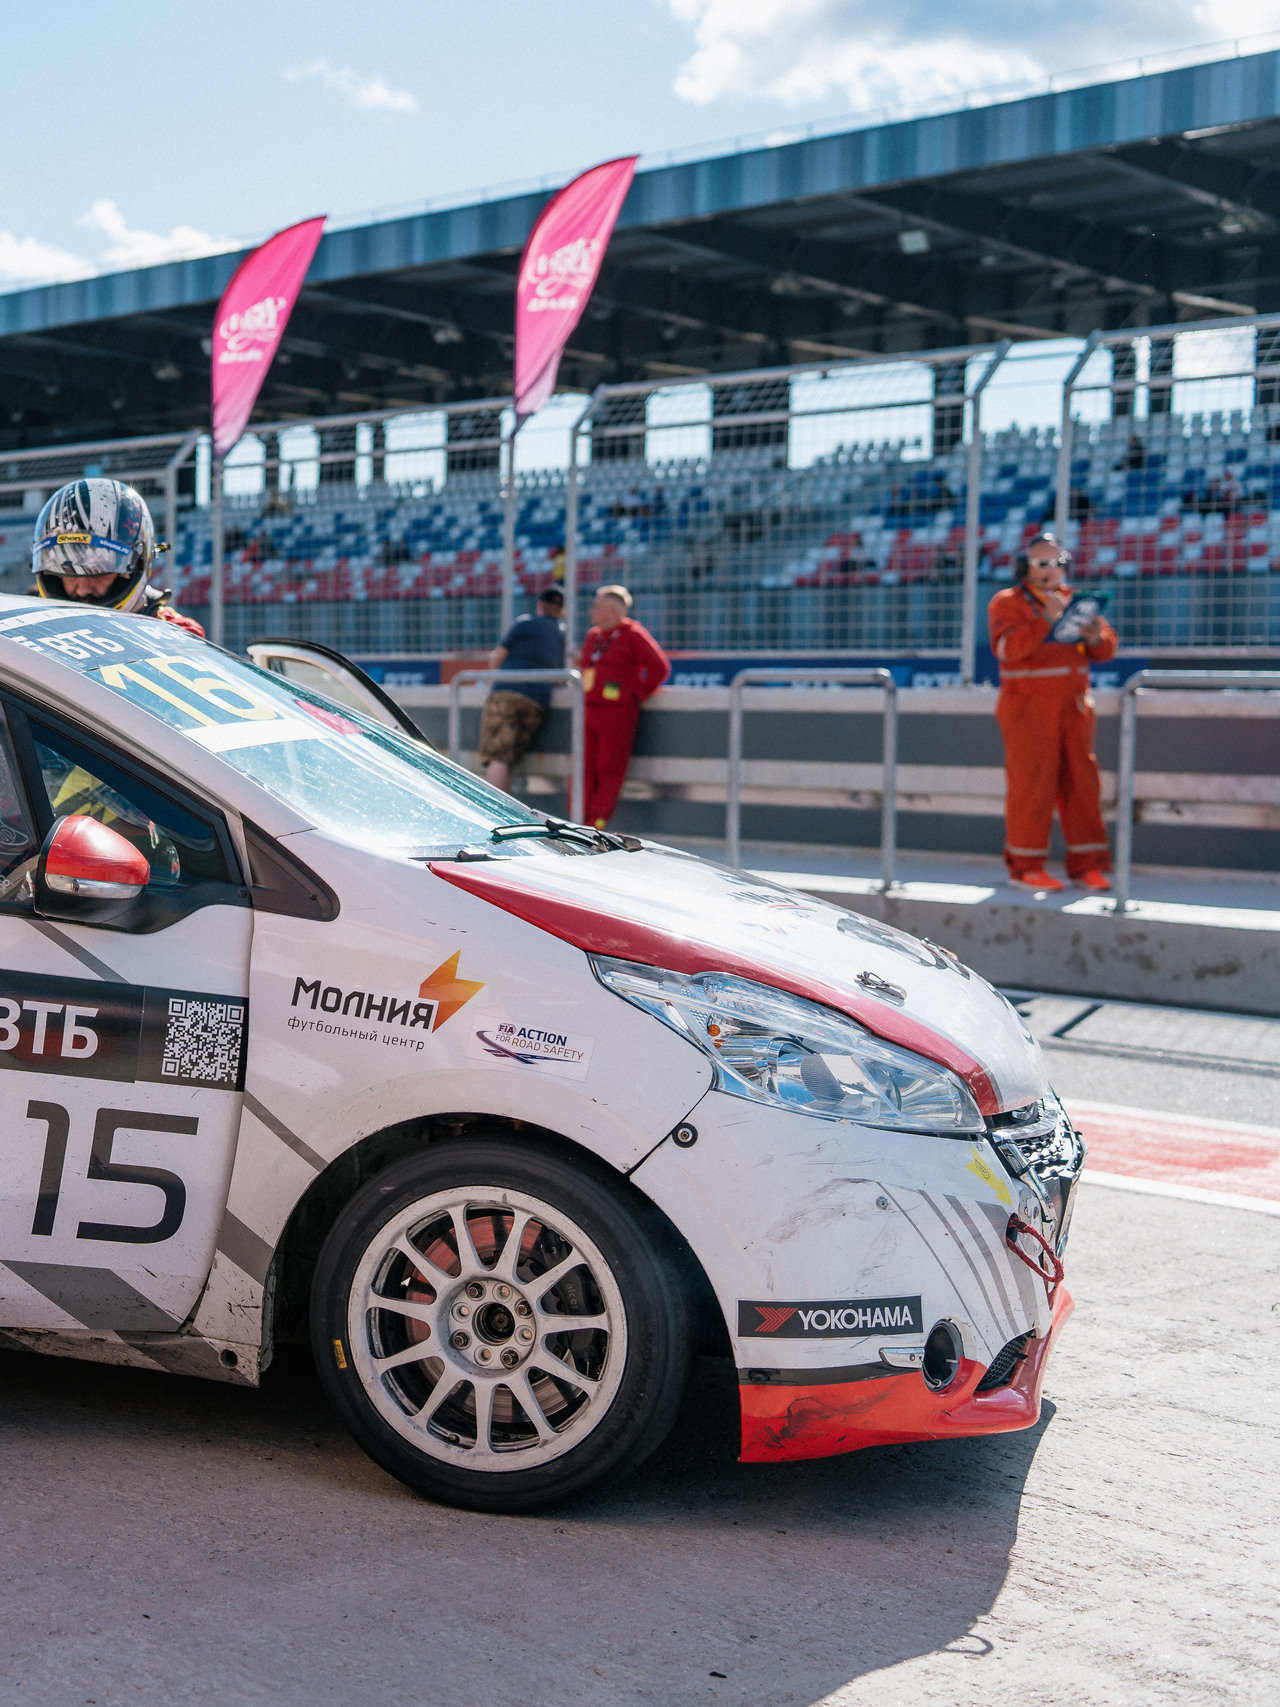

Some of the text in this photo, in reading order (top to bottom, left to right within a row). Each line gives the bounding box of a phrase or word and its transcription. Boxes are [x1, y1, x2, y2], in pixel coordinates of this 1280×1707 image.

[37, 628, 125, 660] ВТБ
[99, 655, 278, 727] 16
[287, 1016, 425, 1052] футбольный центр
[495, 1034, 585, 1060] FOR ROAD SAFETY
[517, 1027, 568, 1047] ACTION
[26, 1100, 200, 1245] 15
[797, 1305, 914, 1331] YOKOHAMA
